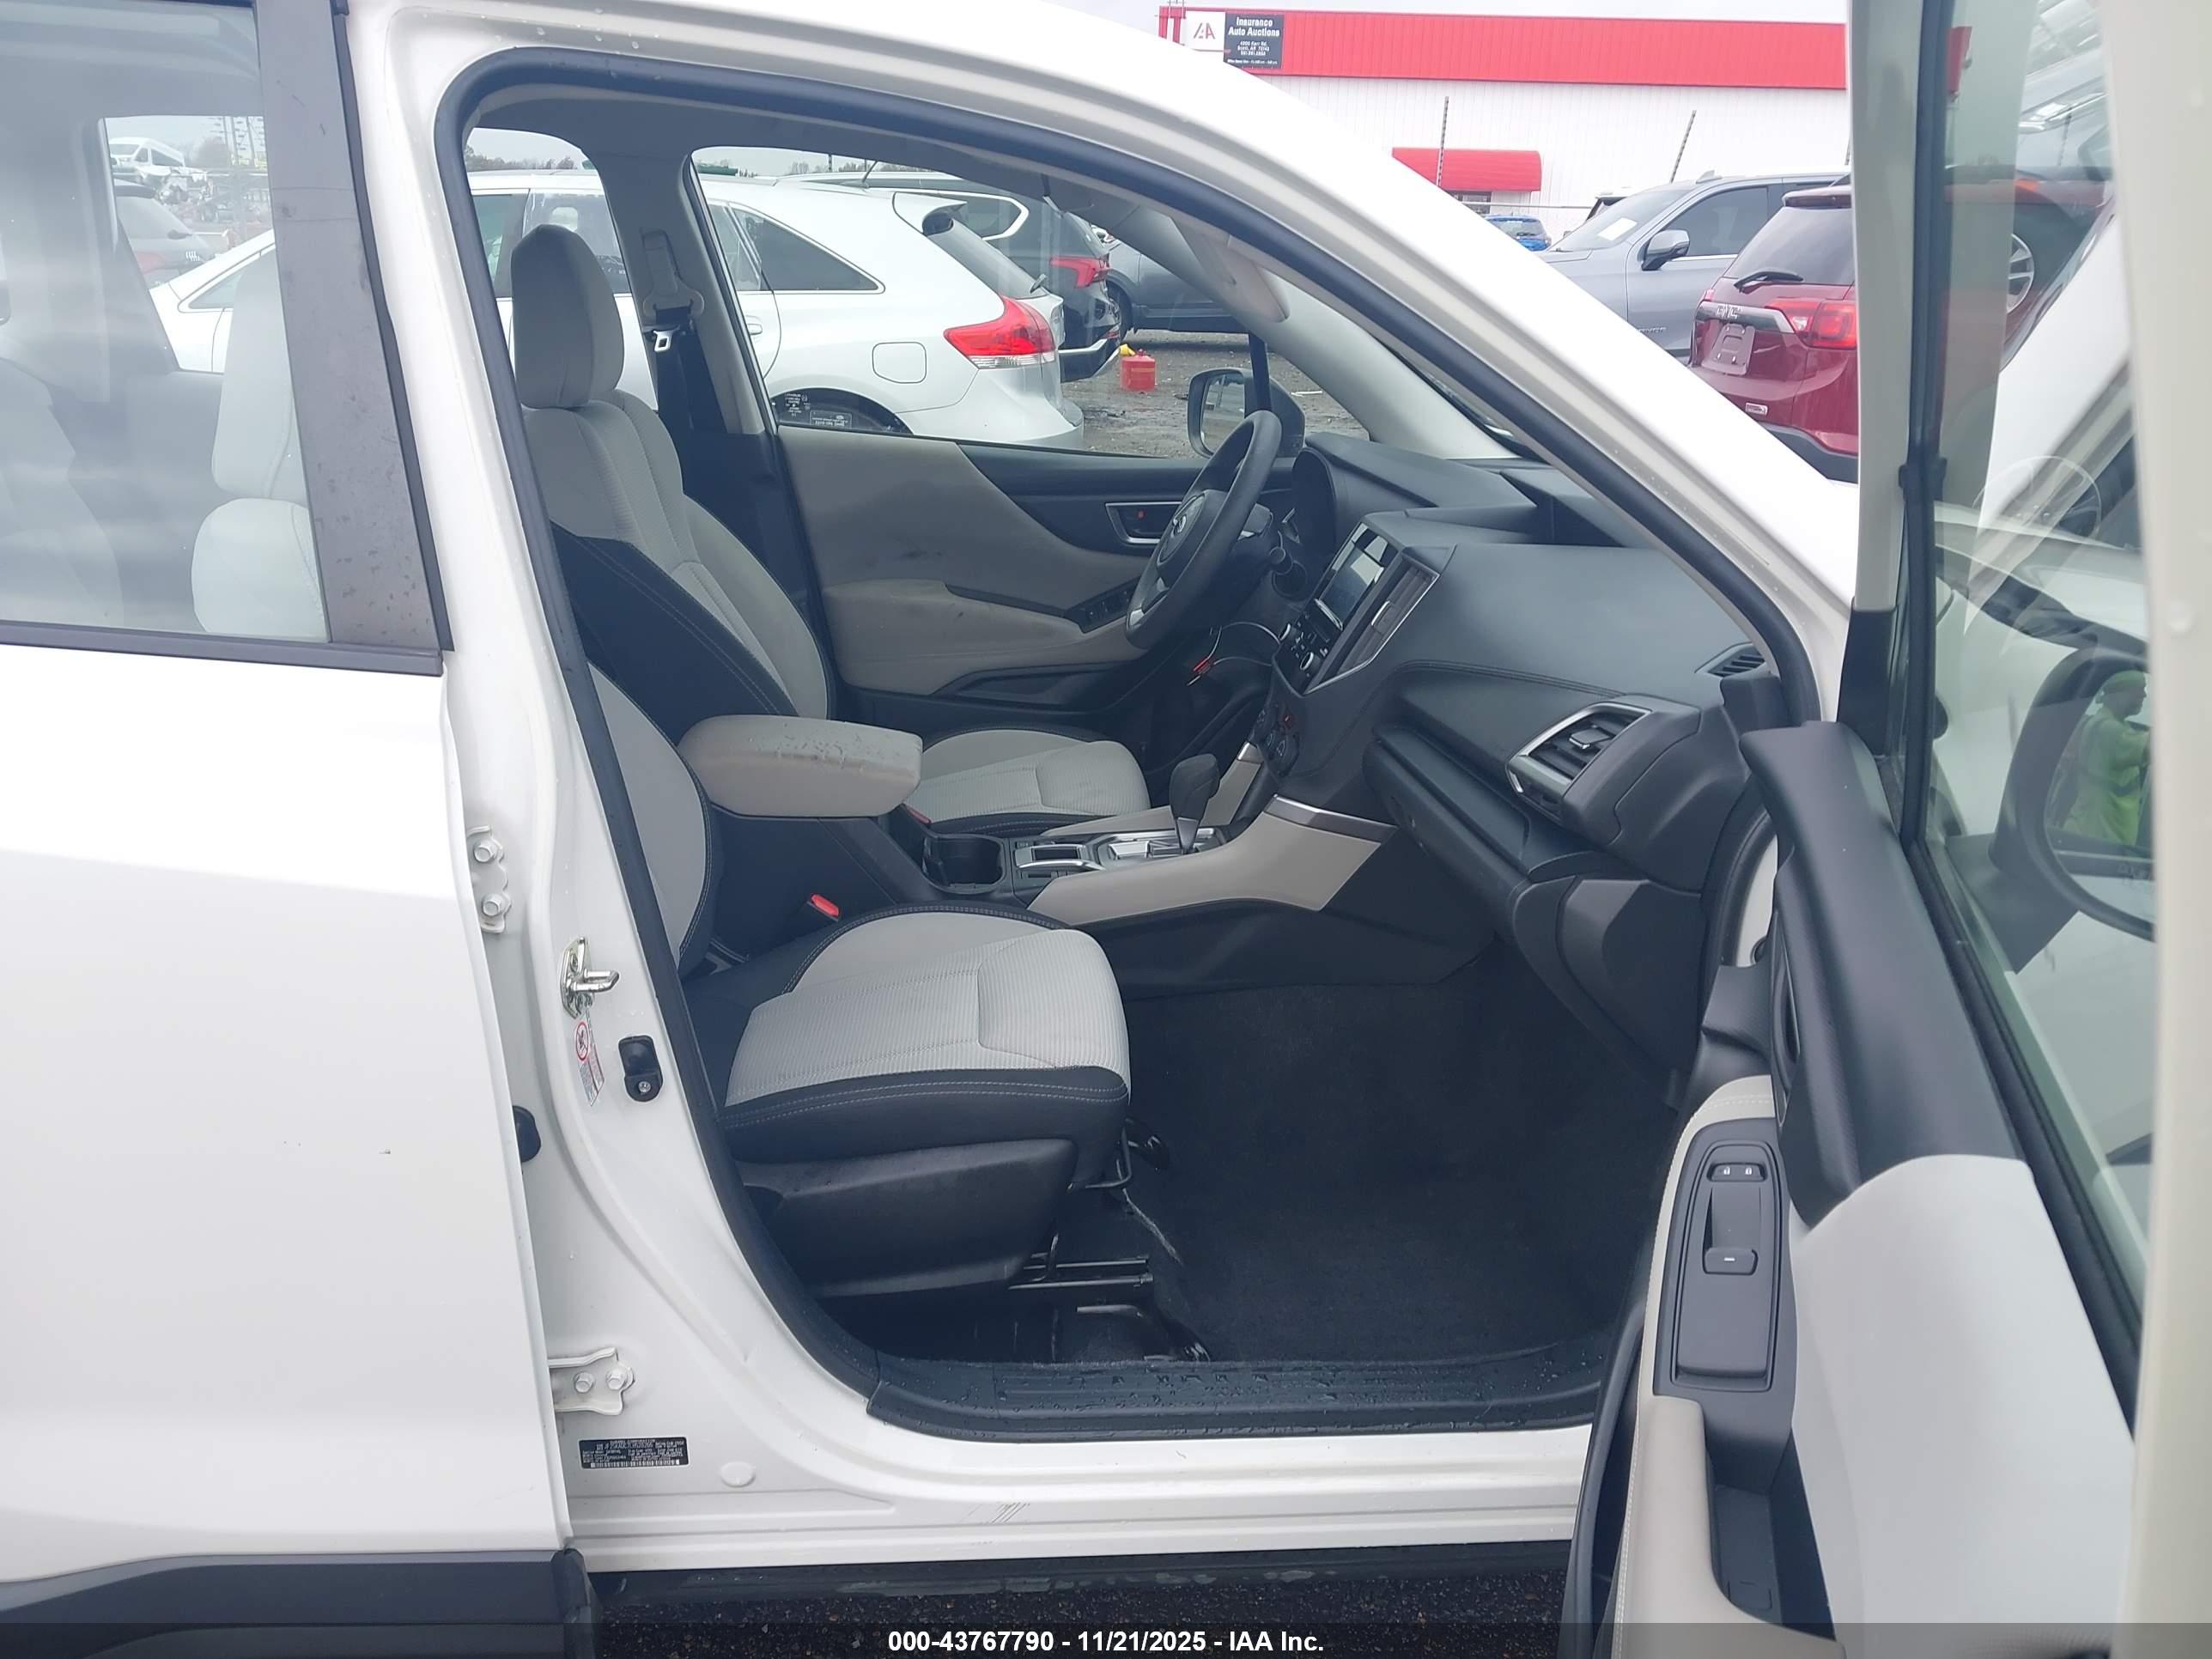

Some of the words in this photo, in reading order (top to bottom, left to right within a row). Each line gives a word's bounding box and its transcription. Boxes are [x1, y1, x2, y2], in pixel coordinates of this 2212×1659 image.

[1237, 16, 1273, 27] Insurance
[1228, 27, 1246, 36] Auto
[1247, 27, 1280, 37] Auctions
